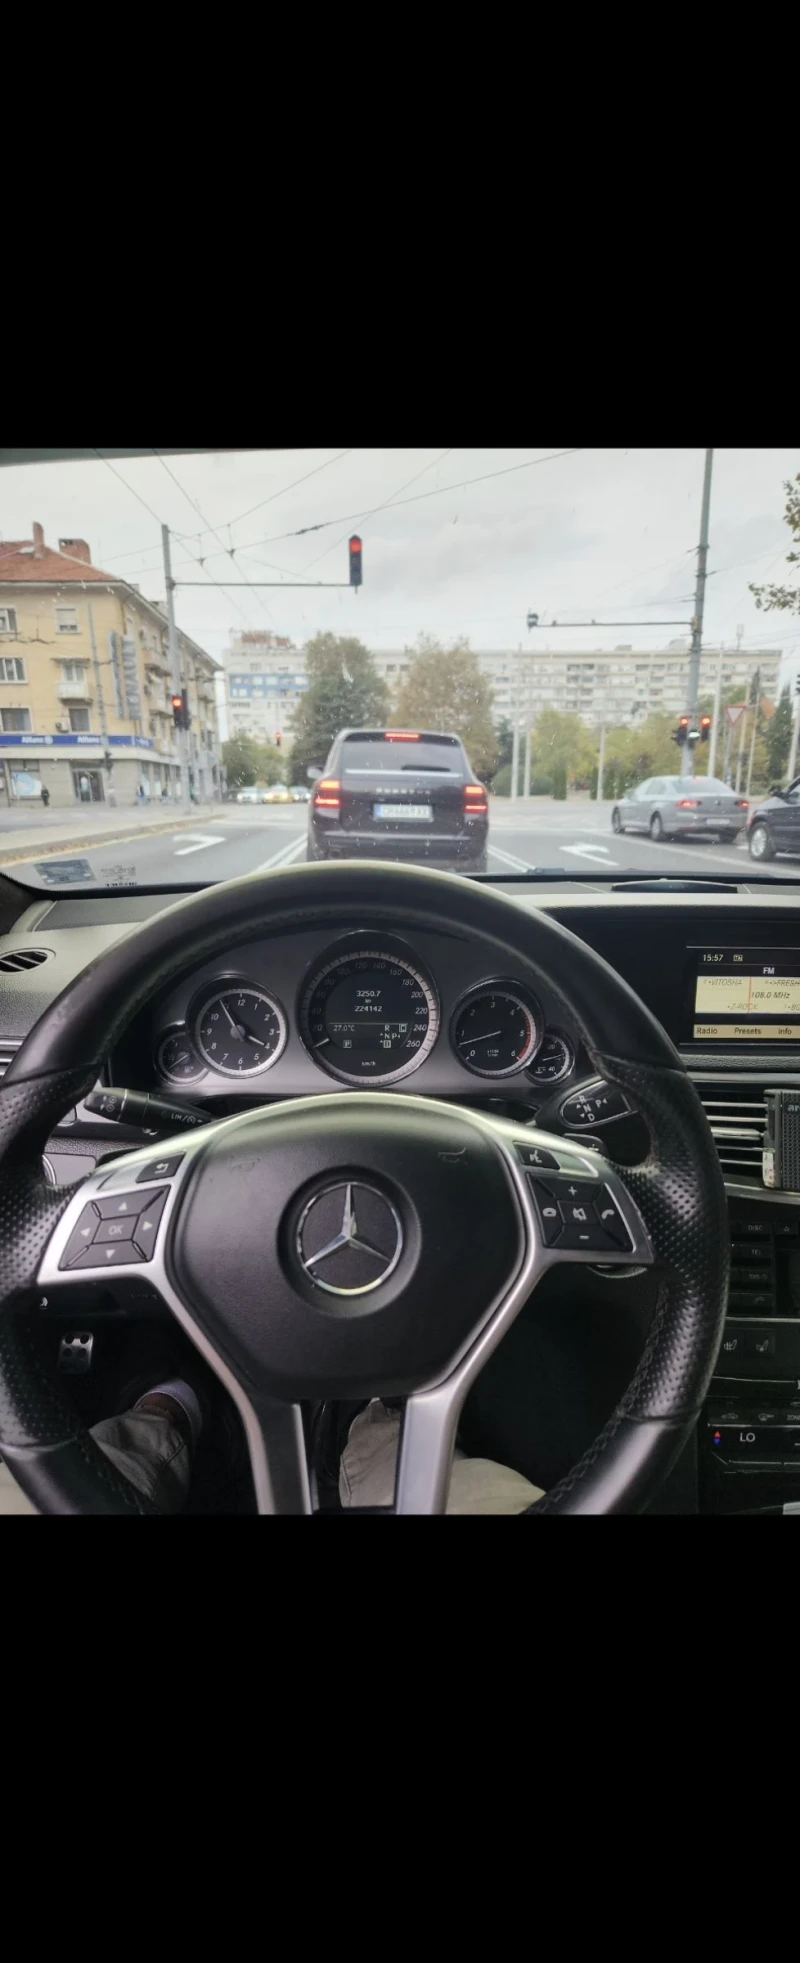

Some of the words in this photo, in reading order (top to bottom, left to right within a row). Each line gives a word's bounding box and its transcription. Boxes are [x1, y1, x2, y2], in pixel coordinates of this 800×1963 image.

[703, 954, 724, 962] 15:57
[402, 978, 414, 986] 180
[696, 1027, 718, 1035] Radio
[734, 1027, 762, 1035] Presets
[406, 1040, 421, 1048] 260
[579, 1095, 587, 1104] R
[595, 1100, 602, 1108] P
[583, 1104, 592, 1113] N
[587, 1113, 595, 1122] D
[108, 1225, 124, 1235] OK
[740, 1432, 755, 1442] LO
